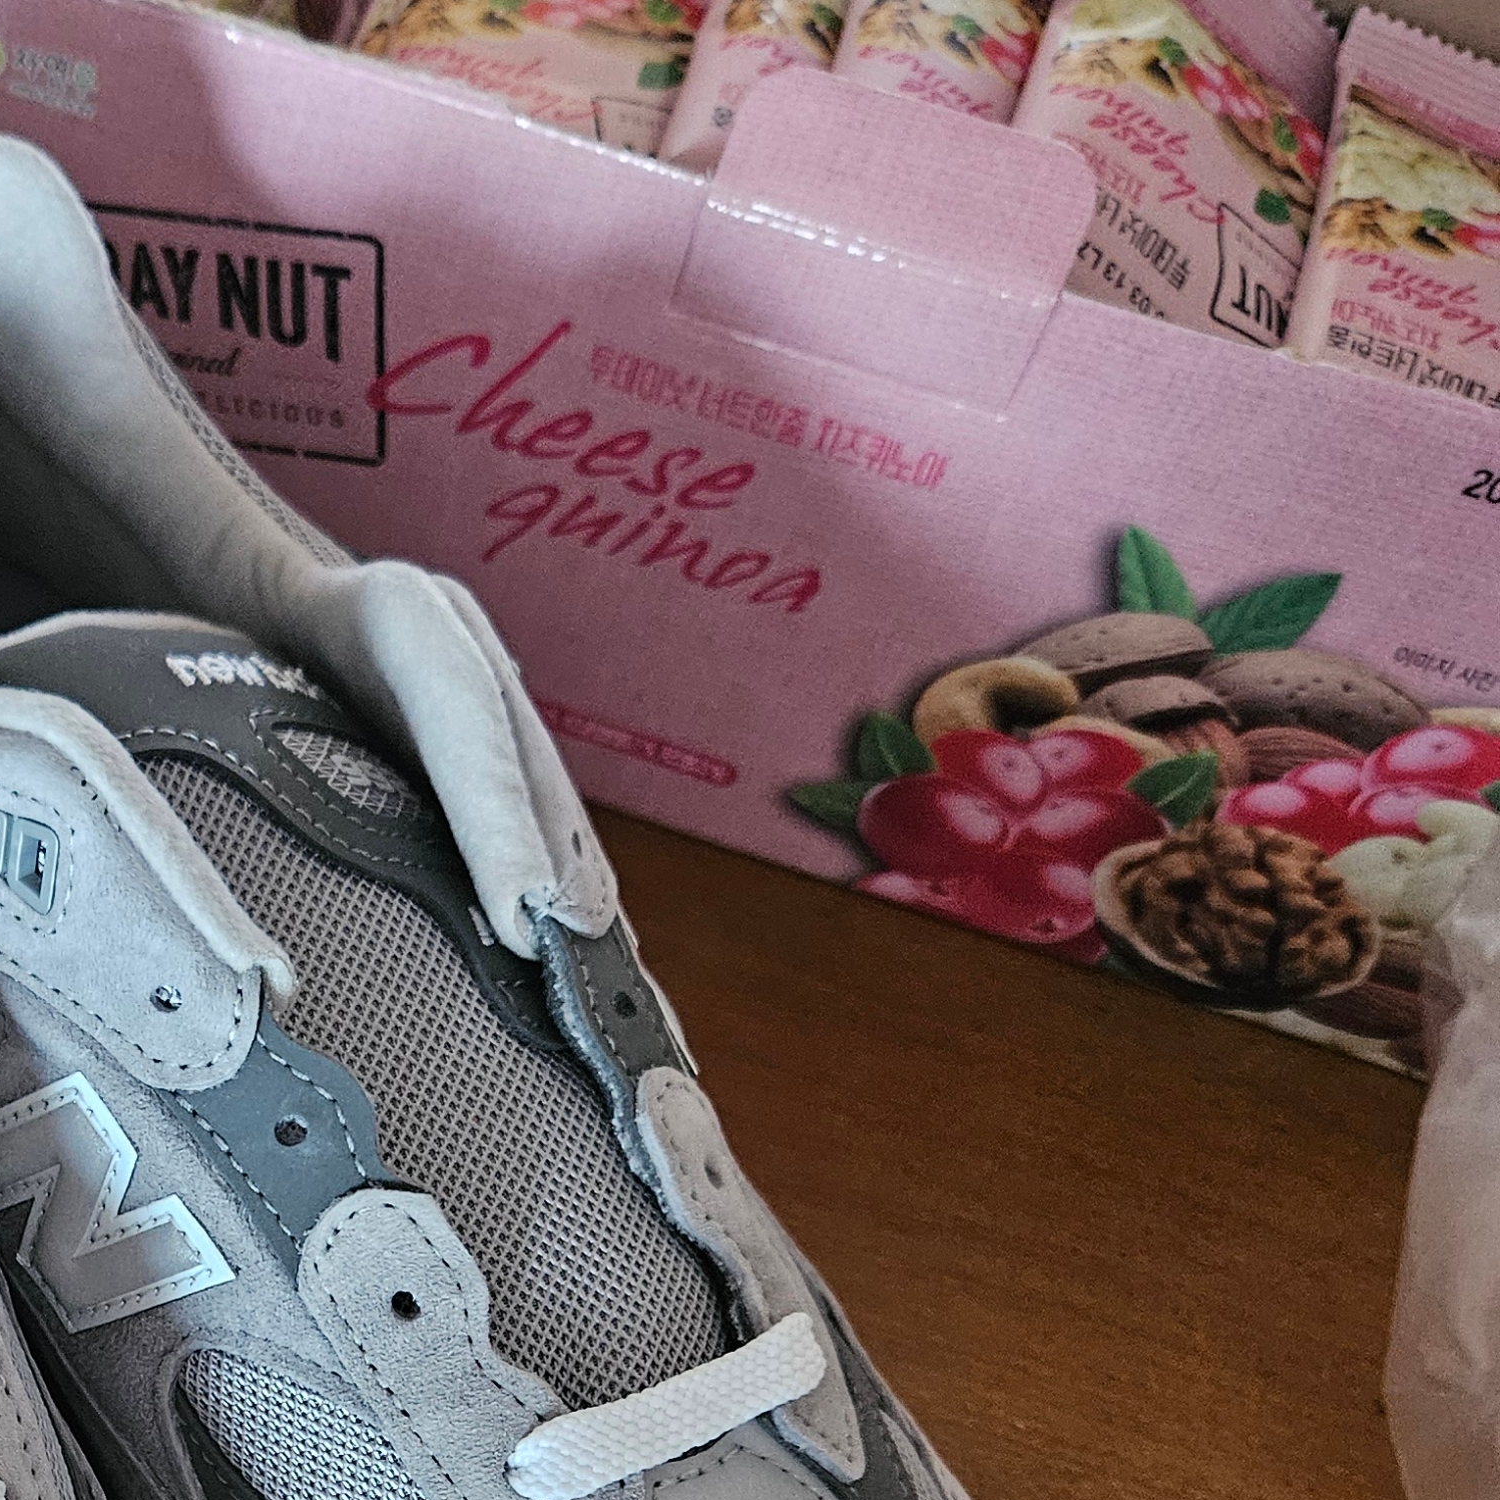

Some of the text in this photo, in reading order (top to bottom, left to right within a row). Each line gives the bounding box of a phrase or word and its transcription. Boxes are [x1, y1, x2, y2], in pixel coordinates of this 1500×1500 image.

[105, 238, 352, 364] AY NUT
[367, 320, 756, 511] Cheese
[481, 484, 823, 615] quinoa
